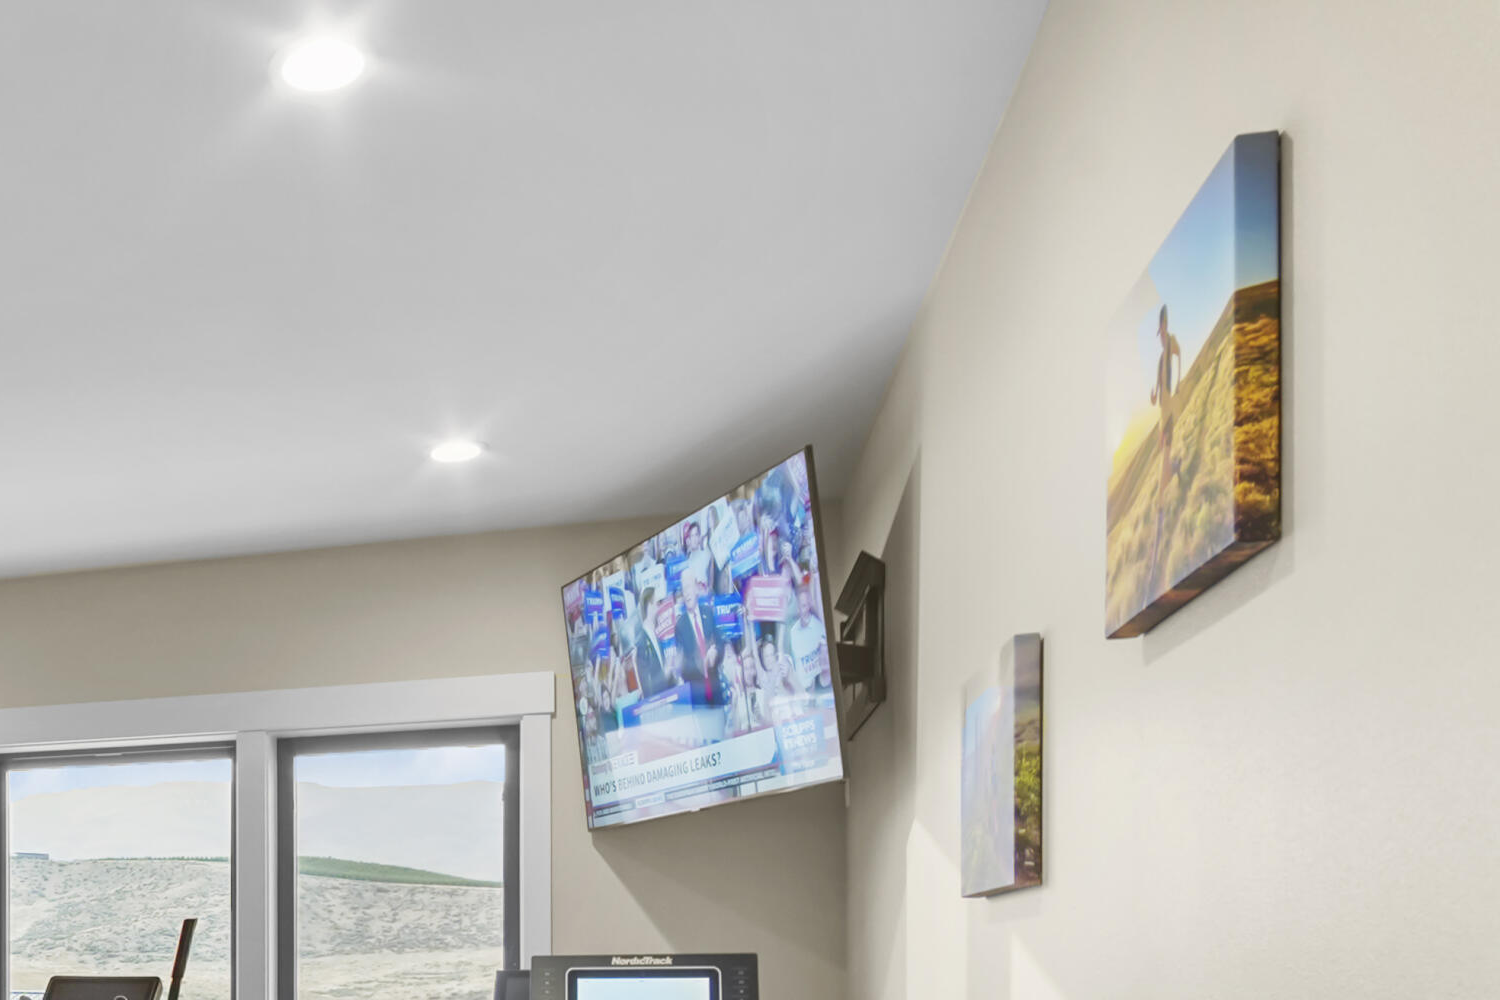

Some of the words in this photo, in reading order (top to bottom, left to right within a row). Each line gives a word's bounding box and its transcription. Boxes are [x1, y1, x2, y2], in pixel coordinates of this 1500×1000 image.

[593, 780, 617, 797] WHO'S
[617, 775, 645, 791] BEHIND
[646, 761, 689, 783] DAMAGING
[690, 751, 721, 772] LEAKS?
[611, 956, 673, 966] NordicTrack
